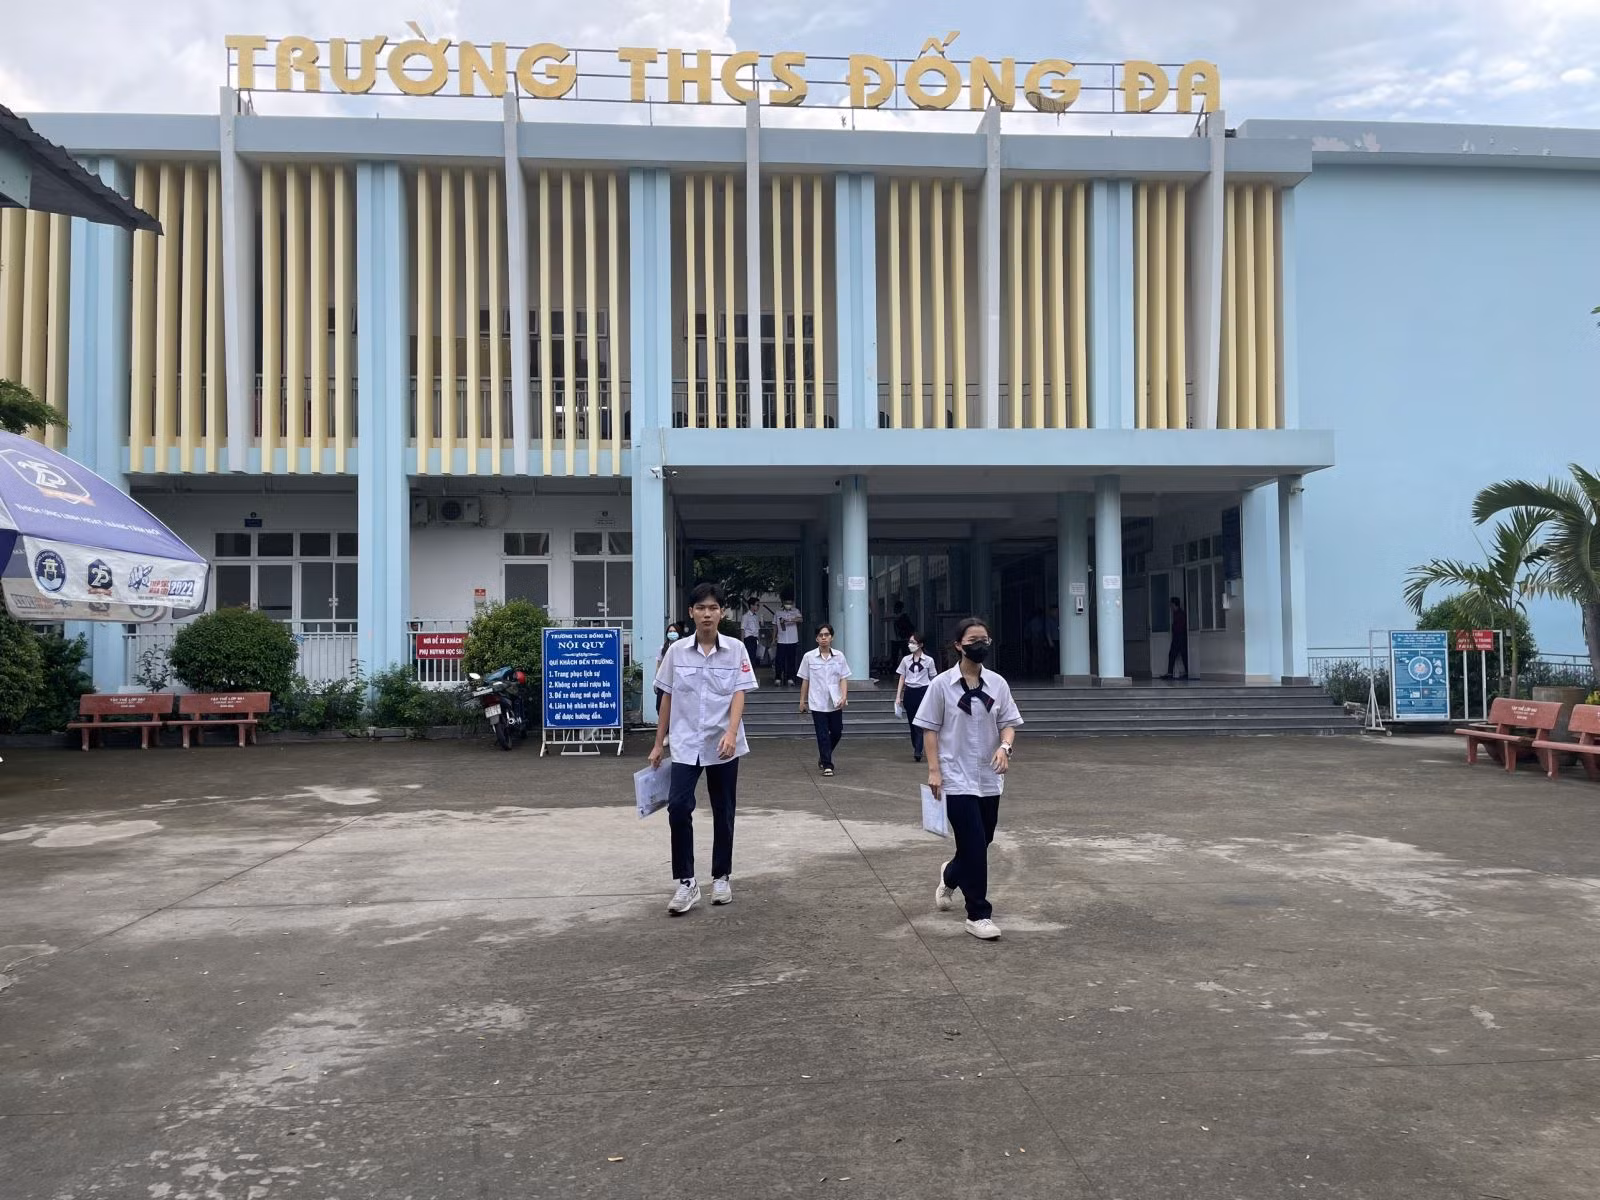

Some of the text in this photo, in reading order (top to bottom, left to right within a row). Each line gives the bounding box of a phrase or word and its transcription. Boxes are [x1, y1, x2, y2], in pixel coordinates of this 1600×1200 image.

[225, 21, 1220, 113] TRƯỜNG THCS ĐỐNG ĐA
[91, 564, 110, 588] 25
[169, 581, 194, 596] 2022
[558, 640, 605, 650] NỘI QUY
[446, 648, 455, 656] HỌC
[560, 658, 577, 666] KHÁCH
[554, 670, 569, 678] Trang
